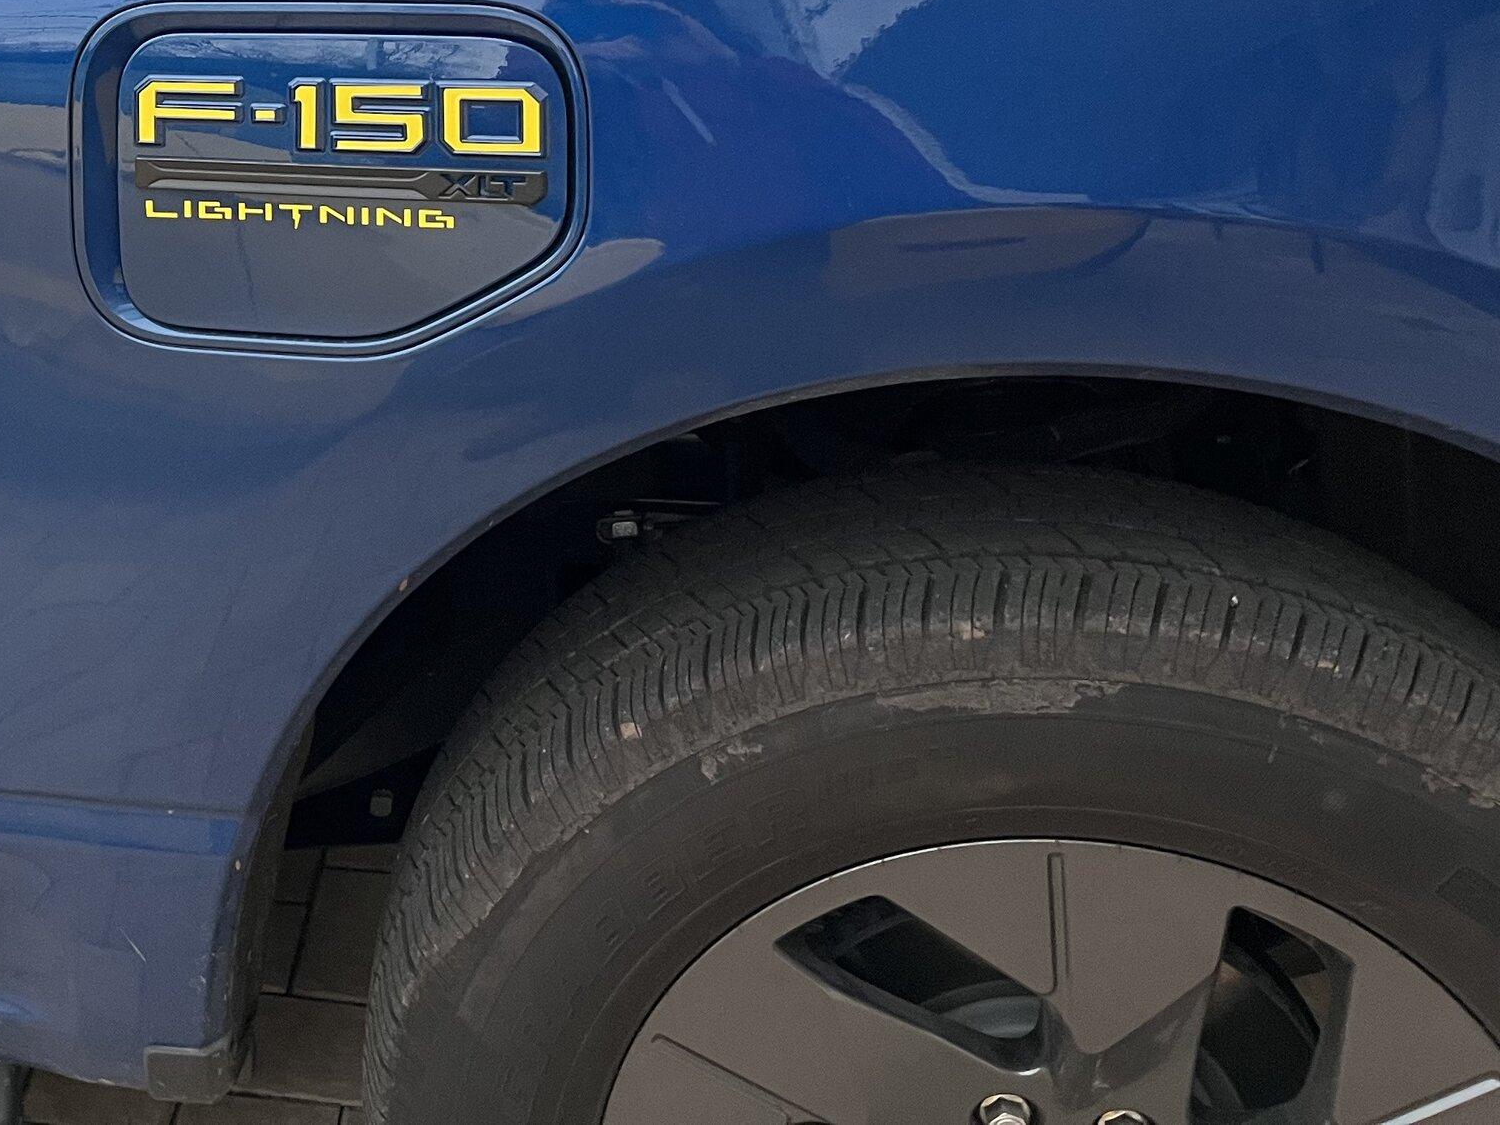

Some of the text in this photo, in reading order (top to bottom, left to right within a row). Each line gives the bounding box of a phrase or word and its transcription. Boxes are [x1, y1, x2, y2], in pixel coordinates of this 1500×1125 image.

[135, 76, 546, 156] F-150
[439, 174, 527, 201] XLT
[145, 200, 455, 230] LIGHTNING
